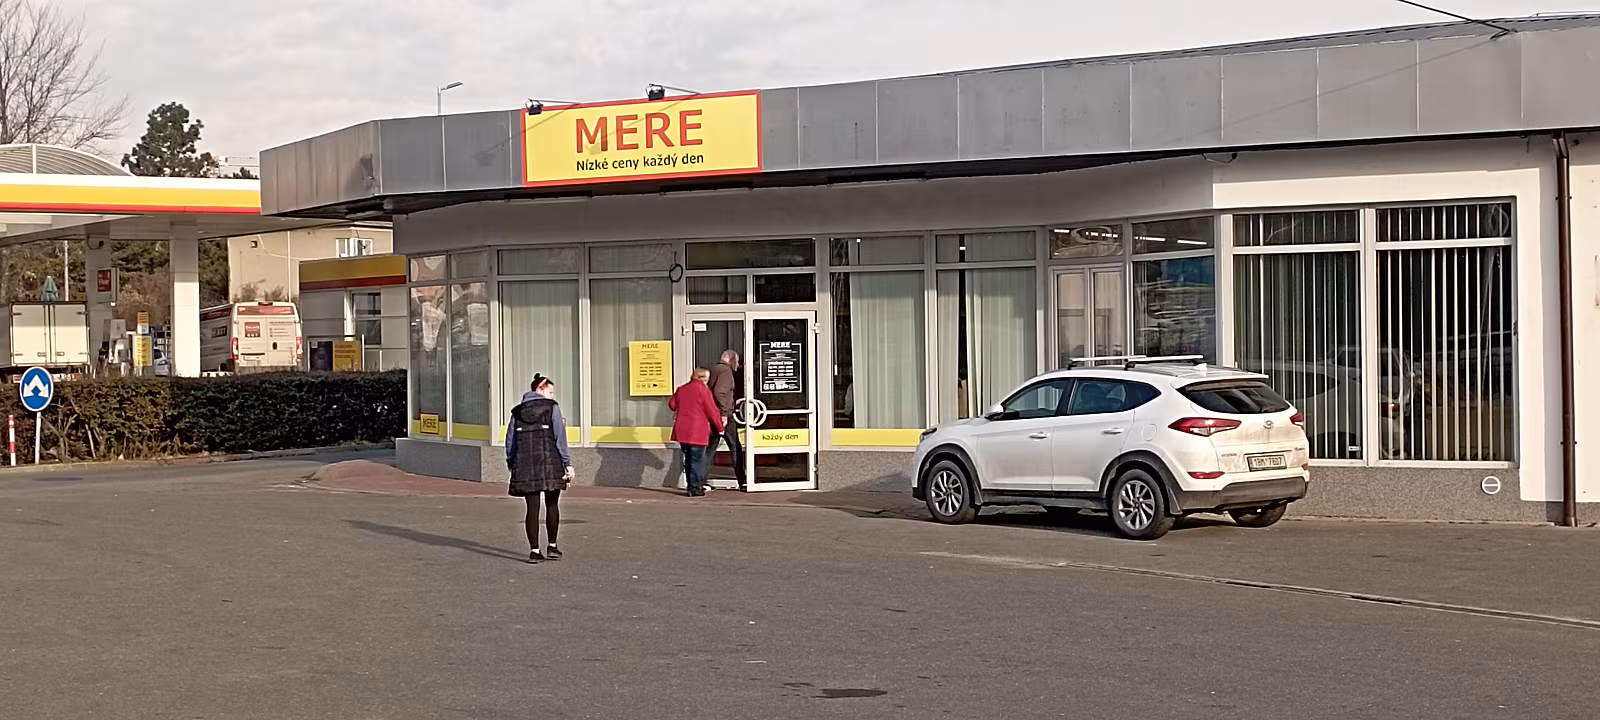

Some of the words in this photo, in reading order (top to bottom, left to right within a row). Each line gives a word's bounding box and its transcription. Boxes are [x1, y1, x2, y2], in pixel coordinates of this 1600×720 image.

[576, 109, 704, 154] MERE
[576, 157, 609, 171] Nízké
[612, 158, 639, 170] ceny
[643, 153, 678, 168] každý
[681, 153, 704, 165] den
[422, 418, 437, 429] MERE
[761, 433, 784, 442] každý
